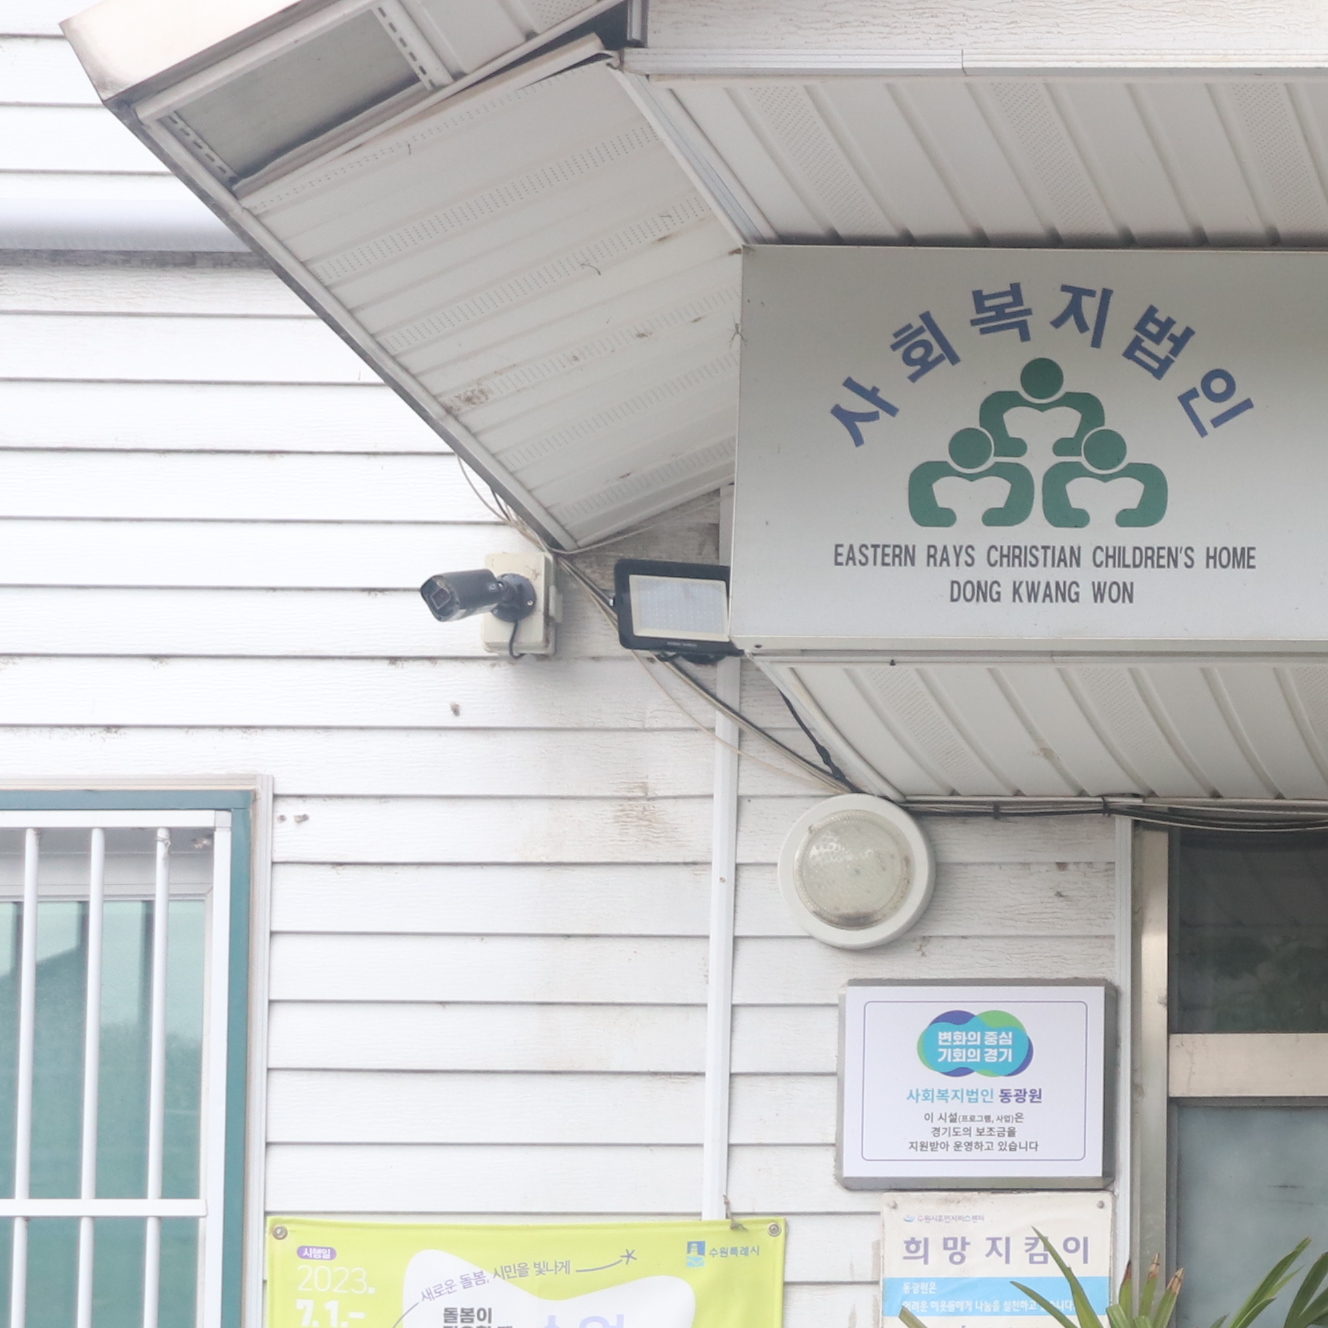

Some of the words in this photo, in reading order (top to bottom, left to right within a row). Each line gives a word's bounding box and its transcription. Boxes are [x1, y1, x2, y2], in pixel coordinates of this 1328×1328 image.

[831, 283, 1253, 447] 사회복지법인
[834, 545, 915, 567] EASTERN
[927, 546, 975, 568] RAYS
[987, 546, 1080, 568] CHRISTIAN
[1092, 546, 1194, 569] CHILDREN'S
[1206, 547, 1256, 569] HOME
[950, 581, 1001, 602] DONG
[1012, 581, 1079, 603] KWANG
[1092, 582, 1134, 603] WON
[938, 1032, 980, 1046] 변화의
[984, 1032, 1012, 1046] 중심
[938, 1048, 980, 1062] 기회의
[984, 1048, 1012, 1062] 경기
[906, 1088, 994, 1103] 사회복지법인
[999, 1088, 1042, 1104] 동광원
[924, 1112, 934, 1122] 이
[931, 1127, 972, 1138] 경기도의
[976, 1126, 1016, 1138] 보조금을
[909, 1141, 950, 1152] 지원받아
[953, 1141, 994, 1152] 운영하고
[998, 1141, 1038, 1152] 있습니다
[303, 1248, 330, 1259] 시행일
[902, 1236, 1089, 1265] 희망지킴이
[296, 1265, 376, 1294] 2023.
[421, 1279, 458, 1303] 새로운
[493, 1262, 529, 1280] 시민을
[534, 1260, 570, 1275] 빛나게
[903, 1283, 936, 1294] 동광원은
[443, 1307, 492, 1324] 돌봄이
